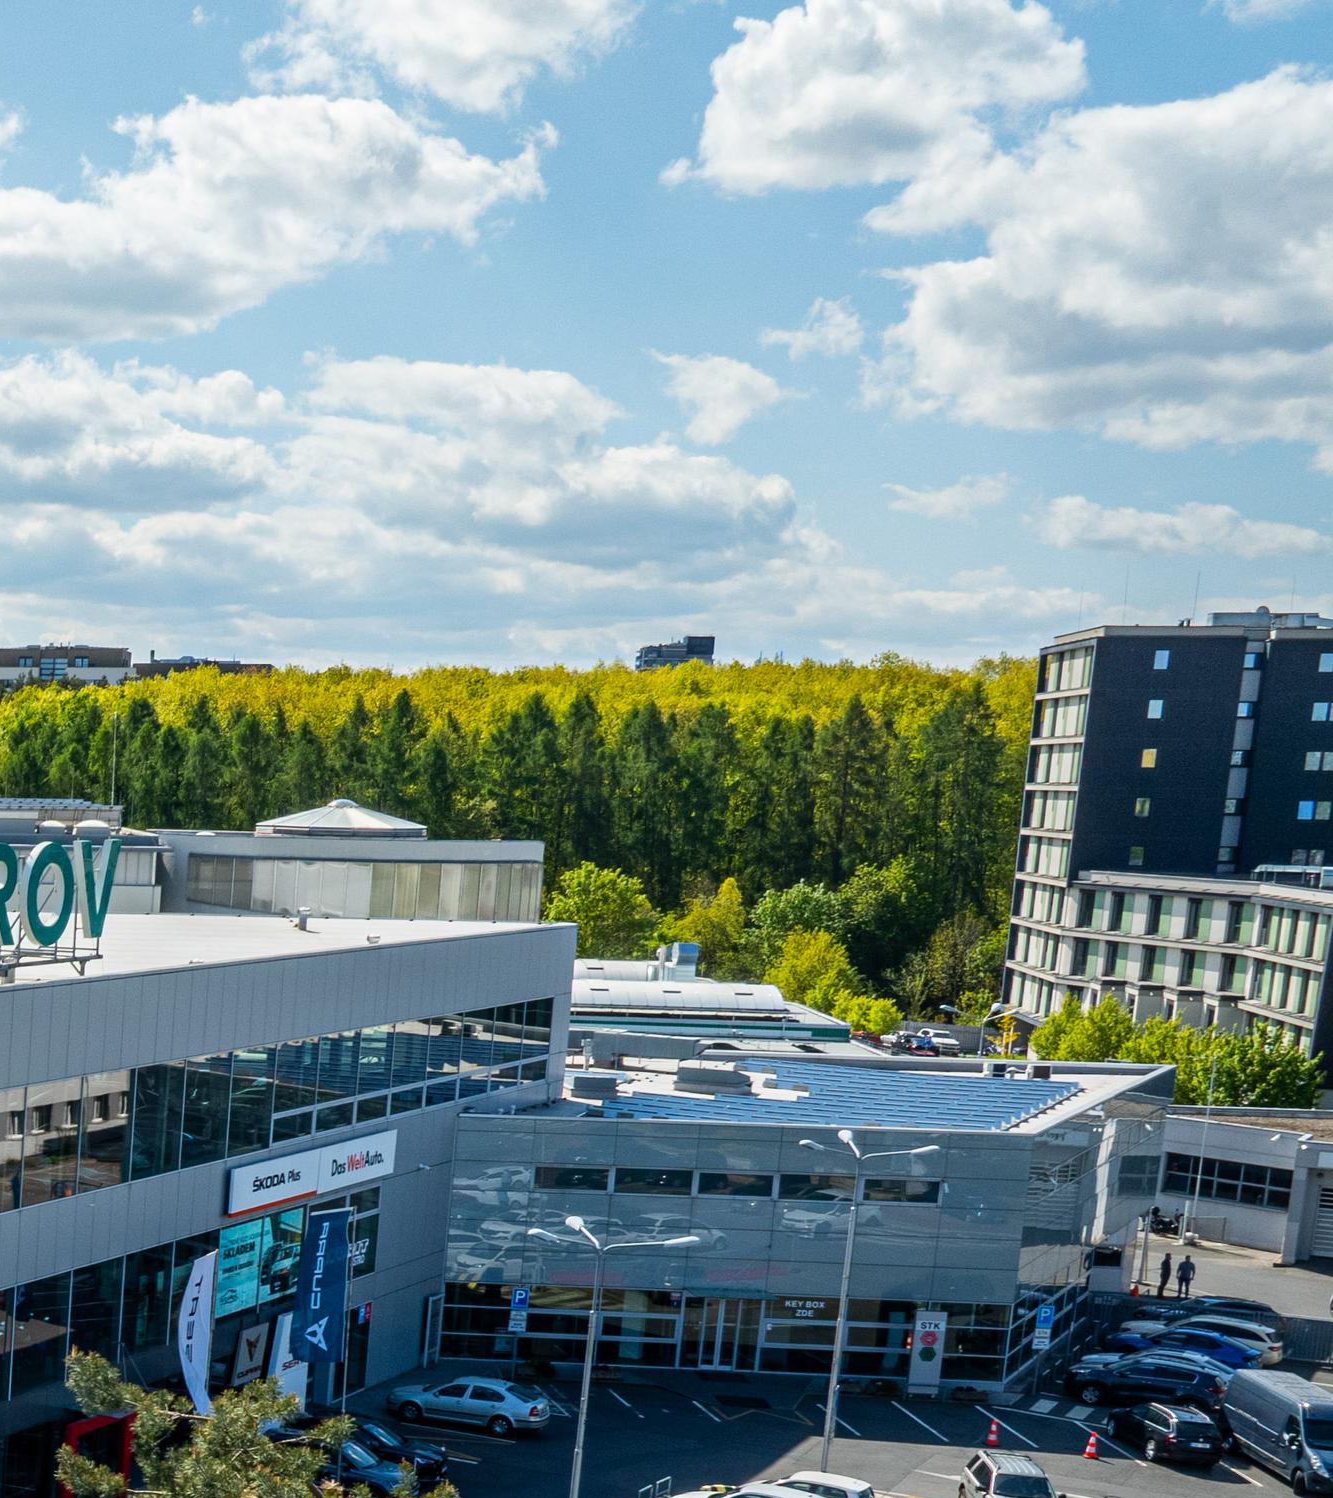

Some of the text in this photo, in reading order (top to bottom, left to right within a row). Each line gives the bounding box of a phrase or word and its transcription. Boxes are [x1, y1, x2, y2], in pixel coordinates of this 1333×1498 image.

[331, 1159, 346, 1177] Das
[252, 1168, 301, 1193] ŠKODA Plus
[516, 1290, 526, 1303] P
[785, 1300, 825, 1309] KEY BOX
[1041, 1308, 1051, 1321] P
[920, 1321, 940, 1330] STK
